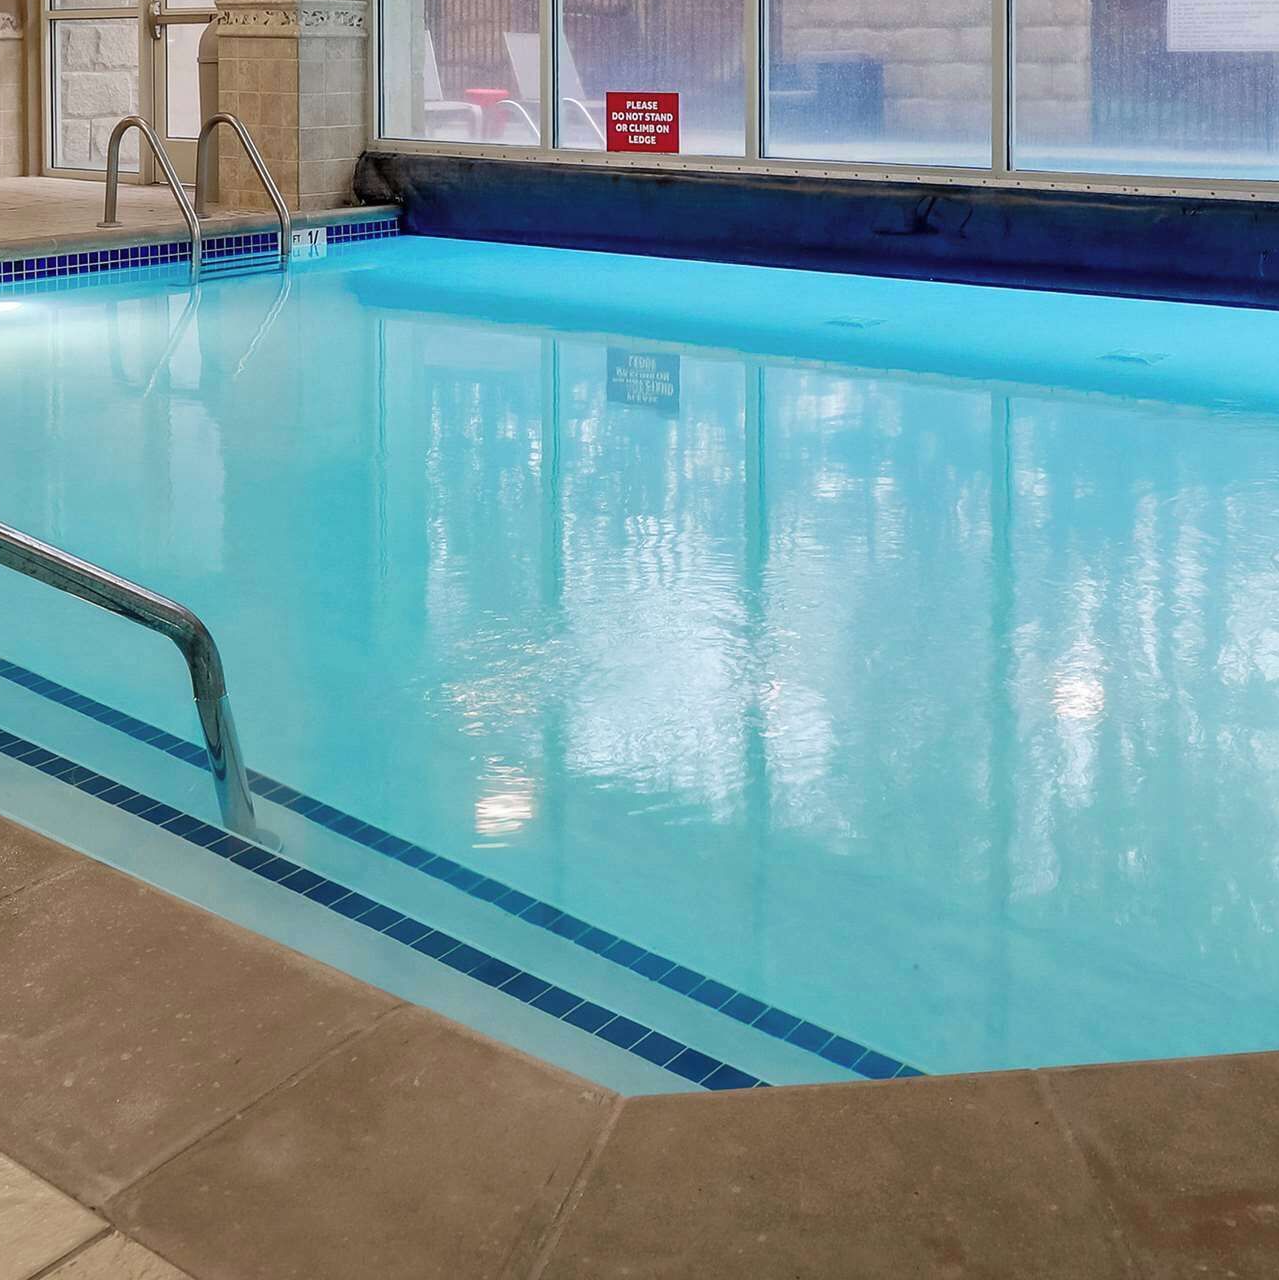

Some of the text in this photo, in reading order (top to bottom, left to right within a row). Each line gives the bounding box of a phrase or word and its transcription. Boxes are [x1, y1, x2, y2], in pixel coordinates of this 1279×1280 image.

[626, 101, 658, 110] PLEASE
[612, 112, 673, 122] DO NOT STAND
[615, 123, 670, 134] OR CLIMB ON
[628, 135, 657, 145] LEDGE
[293, 234, 301, 243] FT
